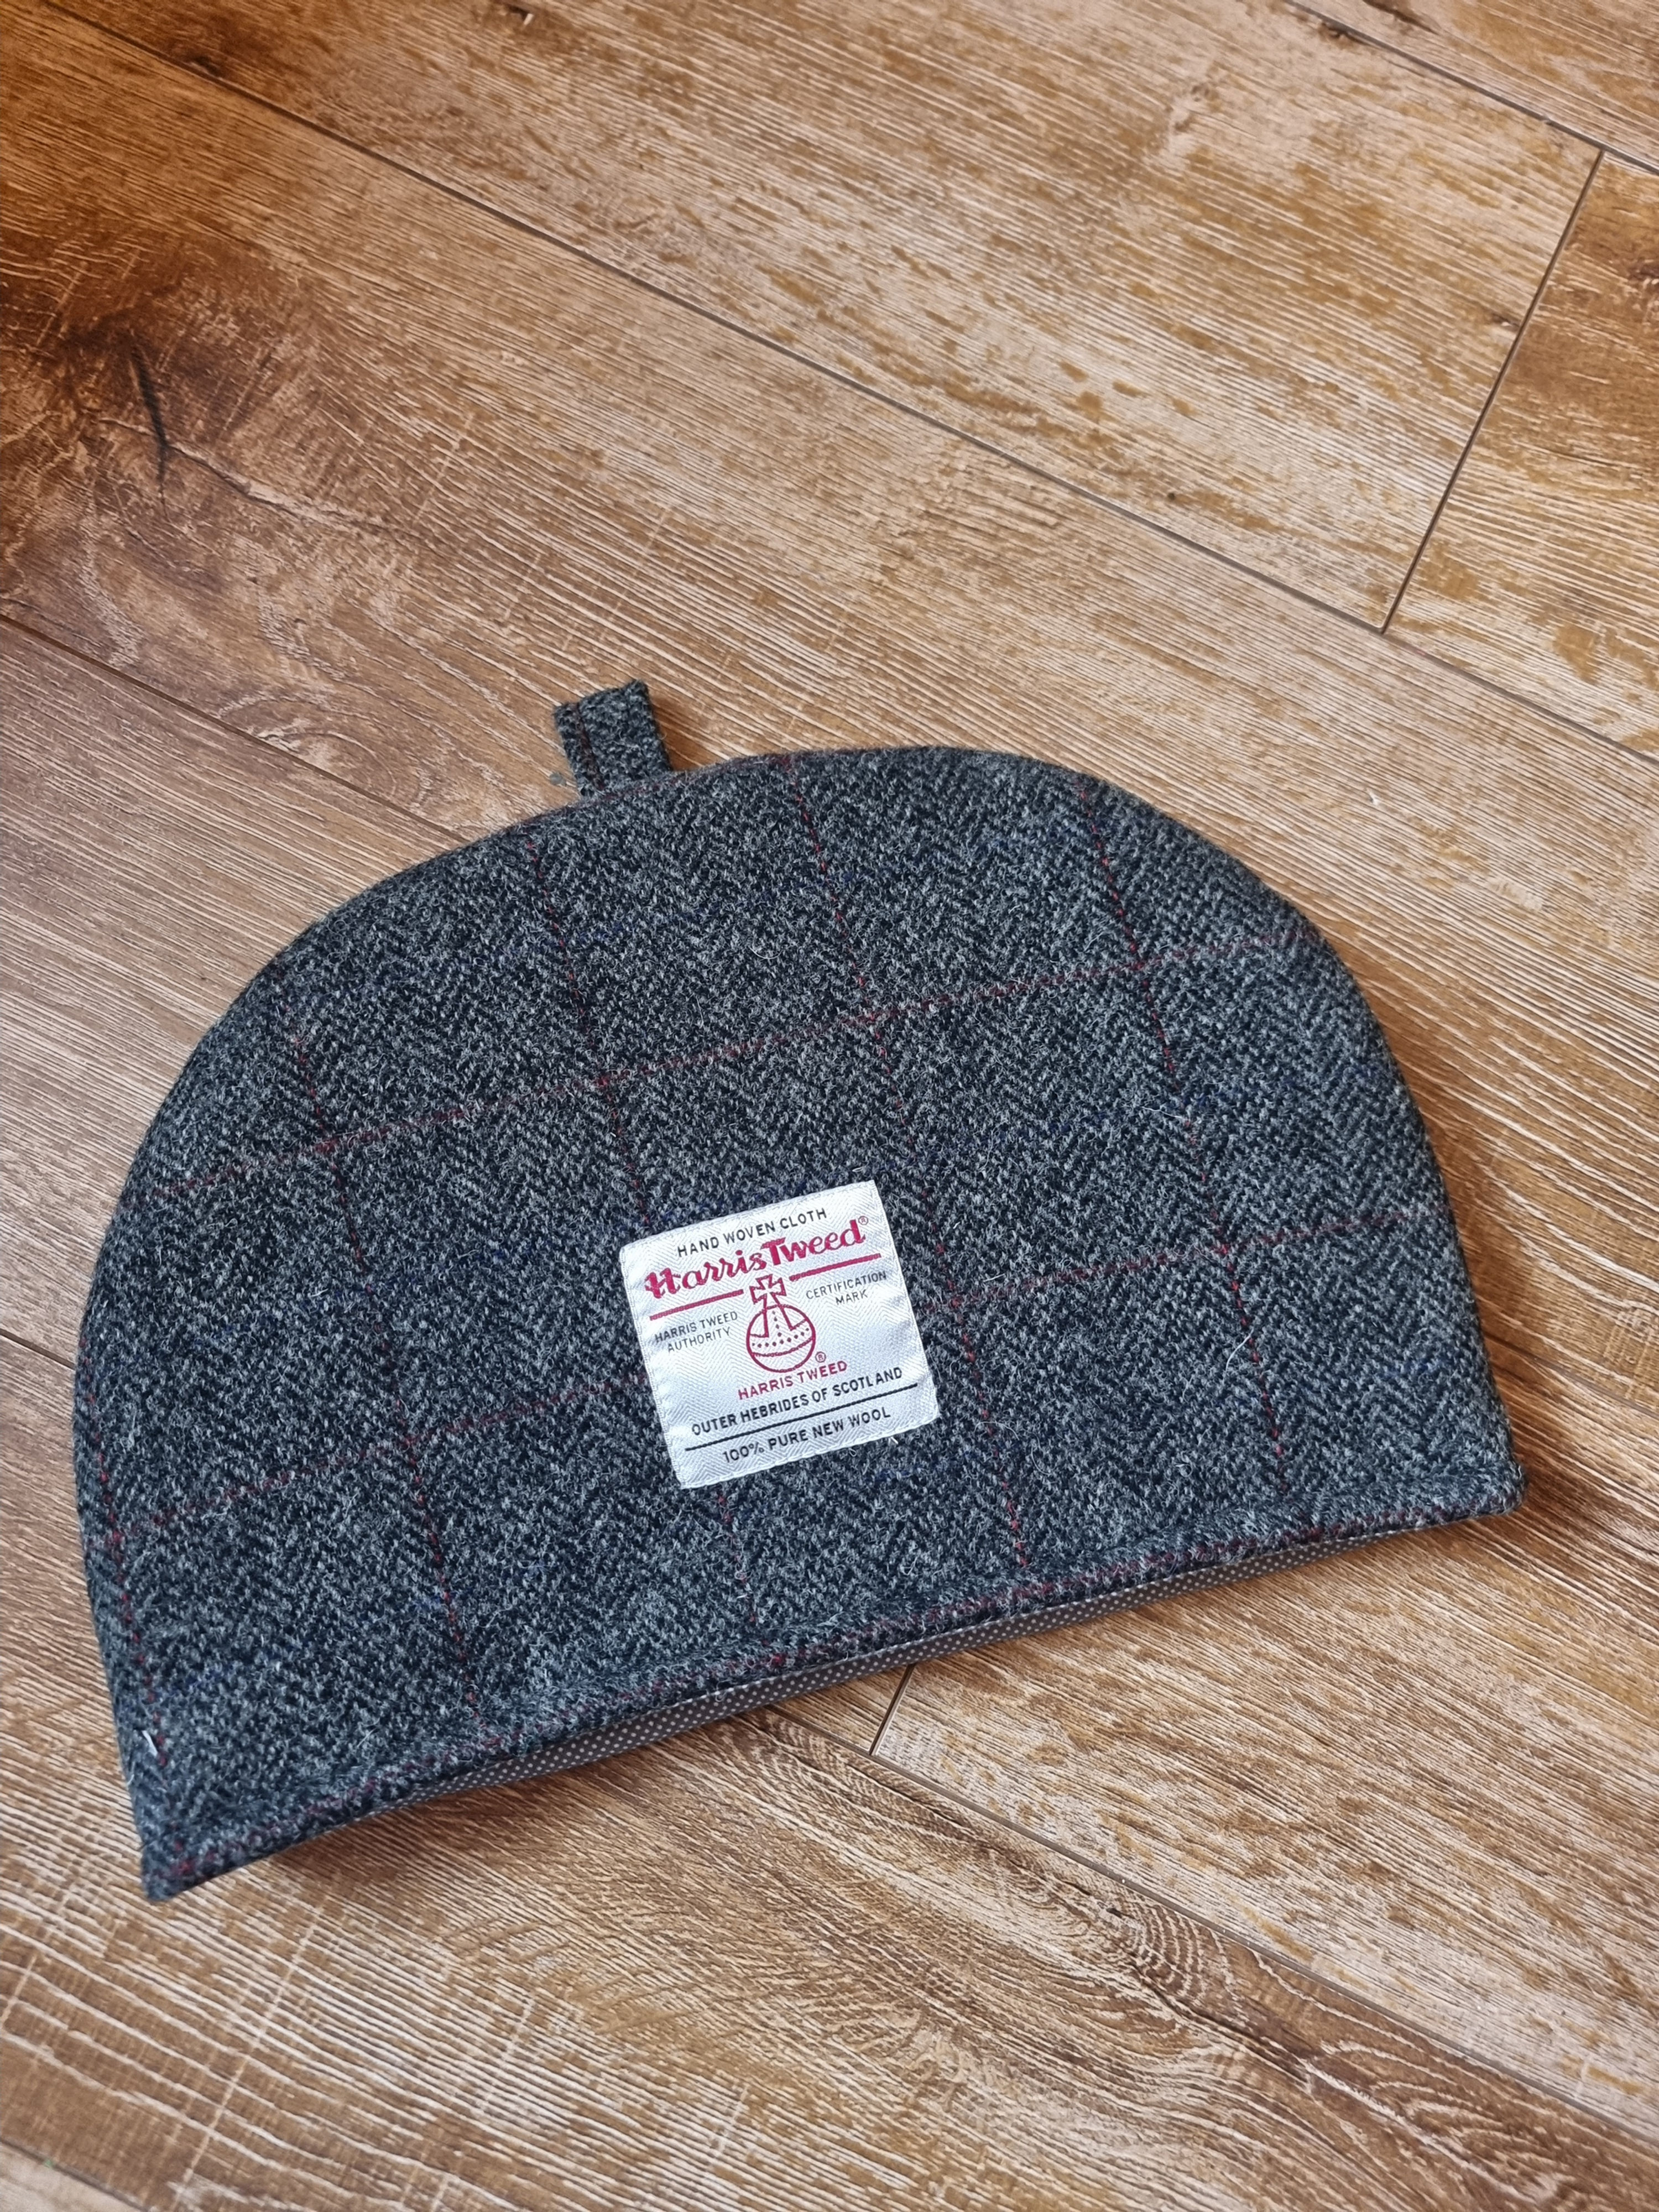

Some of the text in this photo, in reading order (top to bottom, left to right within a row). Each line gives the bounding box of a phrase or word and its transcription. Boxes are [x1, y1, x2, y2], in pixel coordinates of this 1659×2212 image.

[677, 1208, 827, 1257] HAND WOVEN CLOTH
[806, 1271, 887, 1300] CERTIFICATION
[835, 1289, 868, 1305] MARK
[655, 1311, 738, 1343] HARRIS TWEED
[668, 1327, 730, 1353] AUTHORITY
[738, 1360, 847, 1400] HARRIS TWEED
[692, 1367, 902, 1436] OUTER HEBRIDES OF SCOTLAND
[722, 1406, 891, 1463] 100% PURE NEW WOOL
